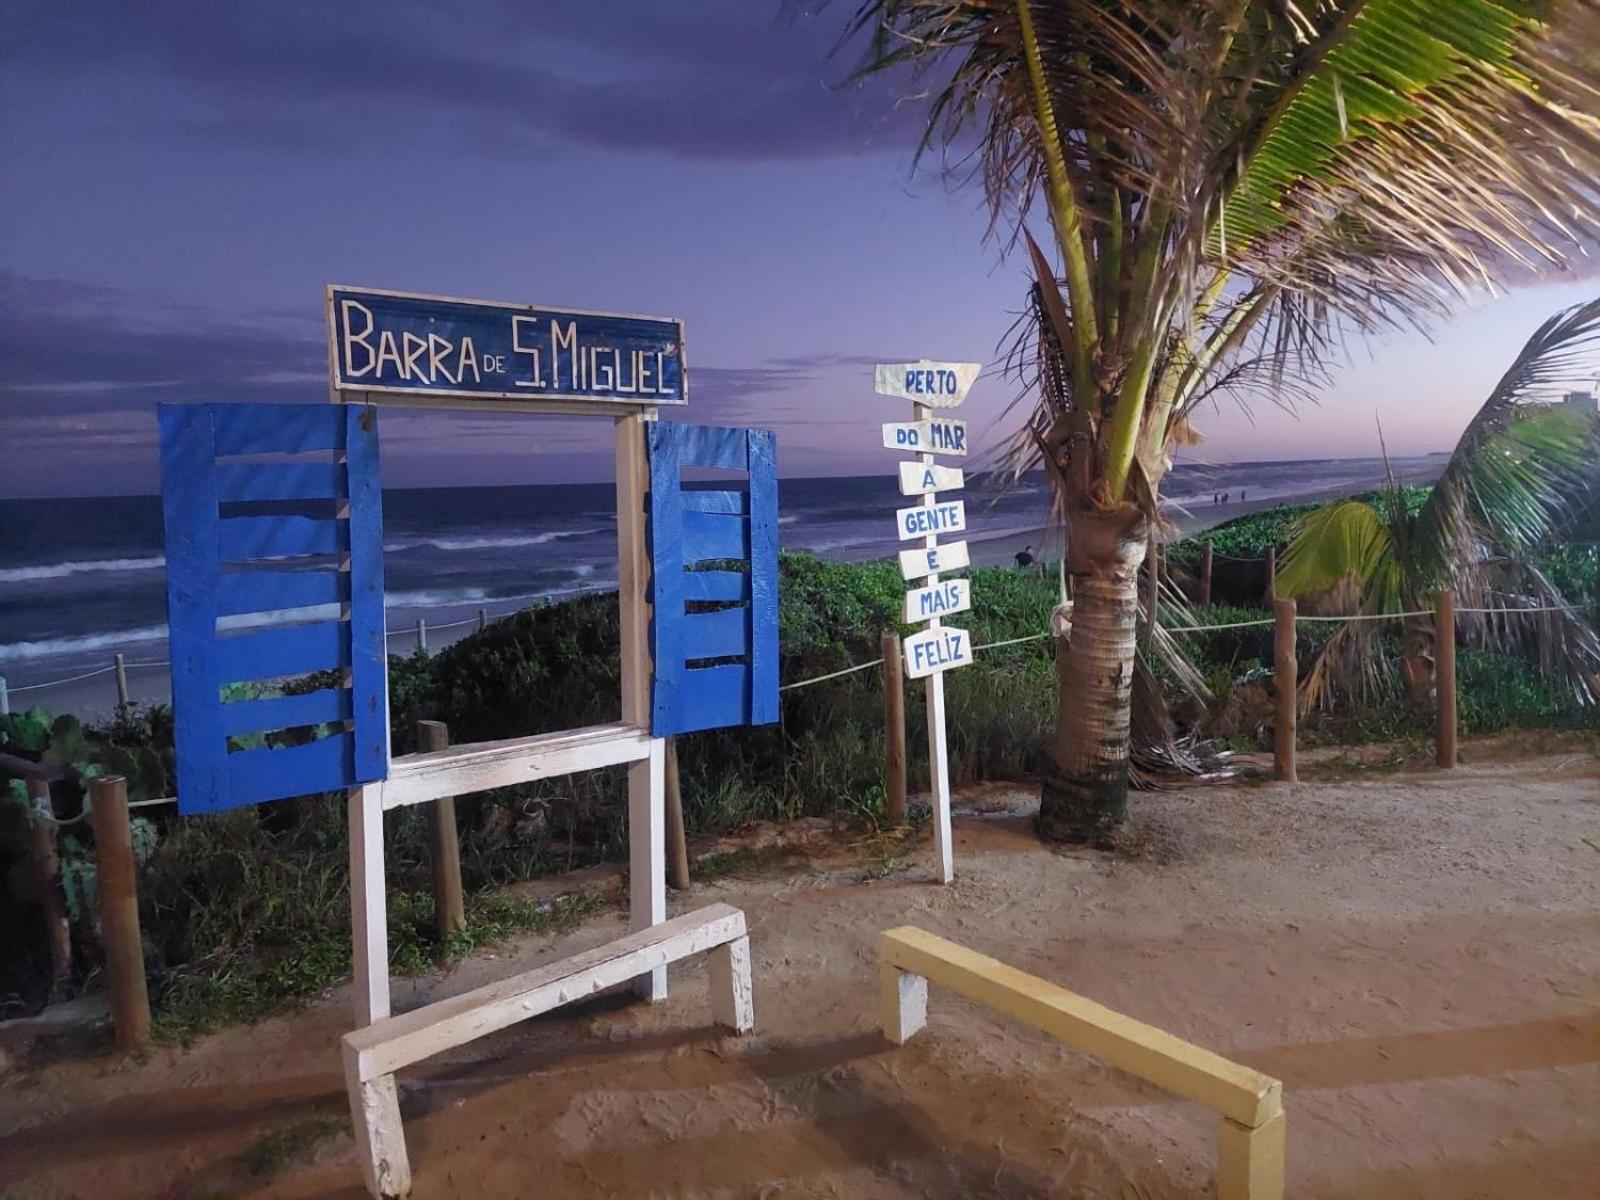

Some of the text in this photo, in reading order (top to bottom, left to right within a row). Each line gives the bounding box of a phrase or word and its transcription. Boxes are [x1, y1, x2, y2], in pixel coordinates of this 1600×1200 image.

[341, 300, 480, 384] BARRA
[484, 354, 506, 374] DE
[905, 370, 957, 395] PERTO
[896, 423, 965, 450] DO MAR
[922, 469, 937, 488] A
[905, 505, 960, 534] GENTE
[913, 633, 964, 670] FELIZ
